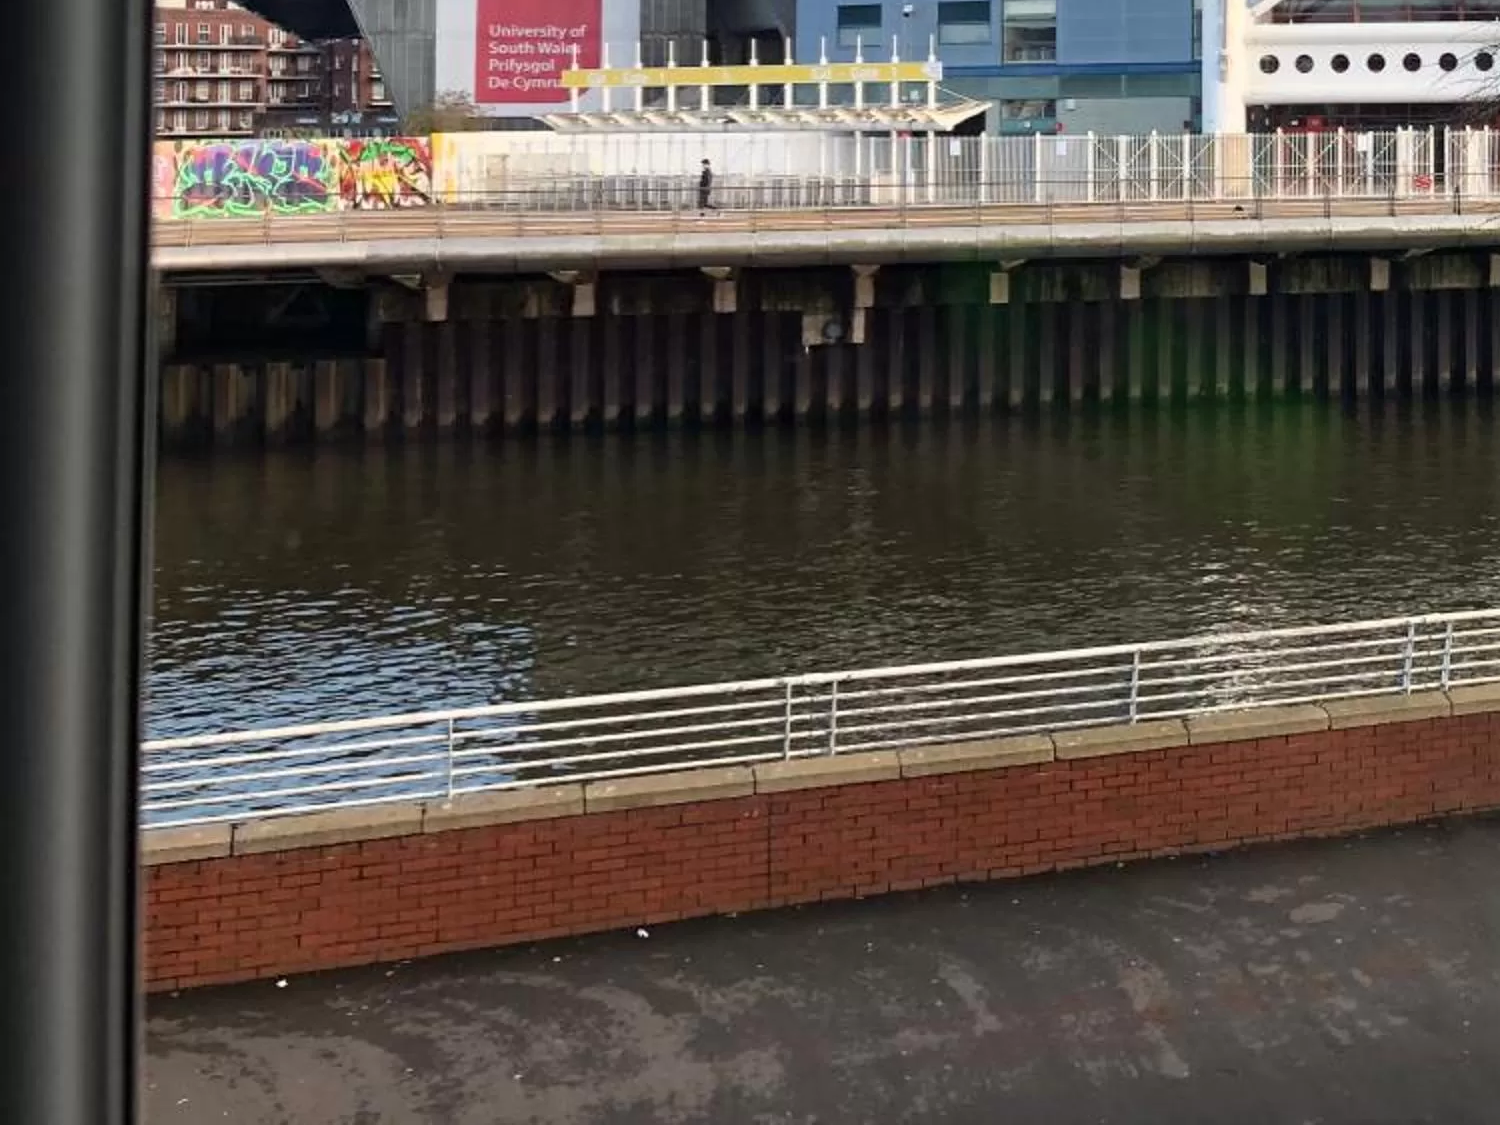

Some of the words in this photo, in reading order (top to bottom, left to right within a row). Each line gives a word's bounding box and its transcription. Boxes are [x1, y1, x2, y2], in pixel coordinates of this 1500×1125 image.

[488, 24, 567, 39] University
[569, 24, 588, 37] of
[488, 41, 534, 54] South
[538, 41, 582, 54] Wales
[489, 58, 555, 74] Prifysgol
[489, 76, 509, 89] De
